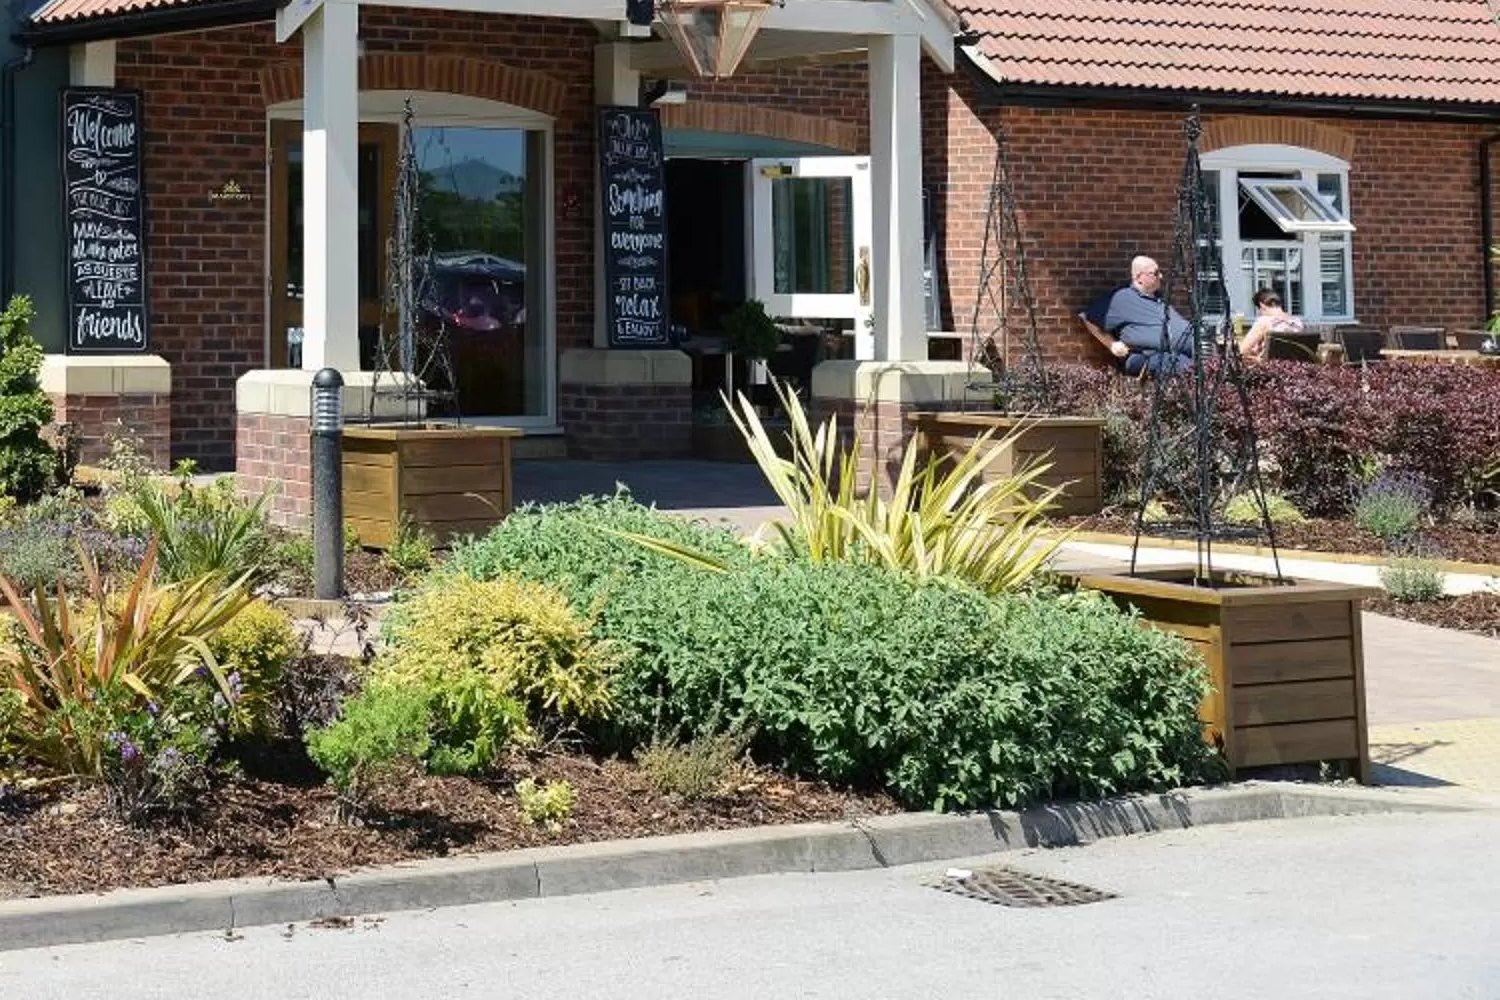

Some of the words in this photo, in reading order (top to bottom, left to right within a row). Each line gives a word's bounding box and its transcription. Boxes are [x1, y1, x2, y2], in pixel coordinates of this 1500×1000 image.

[68, 110, 135, 156] Welcome
[95, 169, 107, 186] to
[609, 183, 663, 217] Something
[611, 231, 663, 255] everyone
[77, 264, 92, 276] AS
[615, 293, 661, 319] relax
[77, 307, 142, 345] friends
